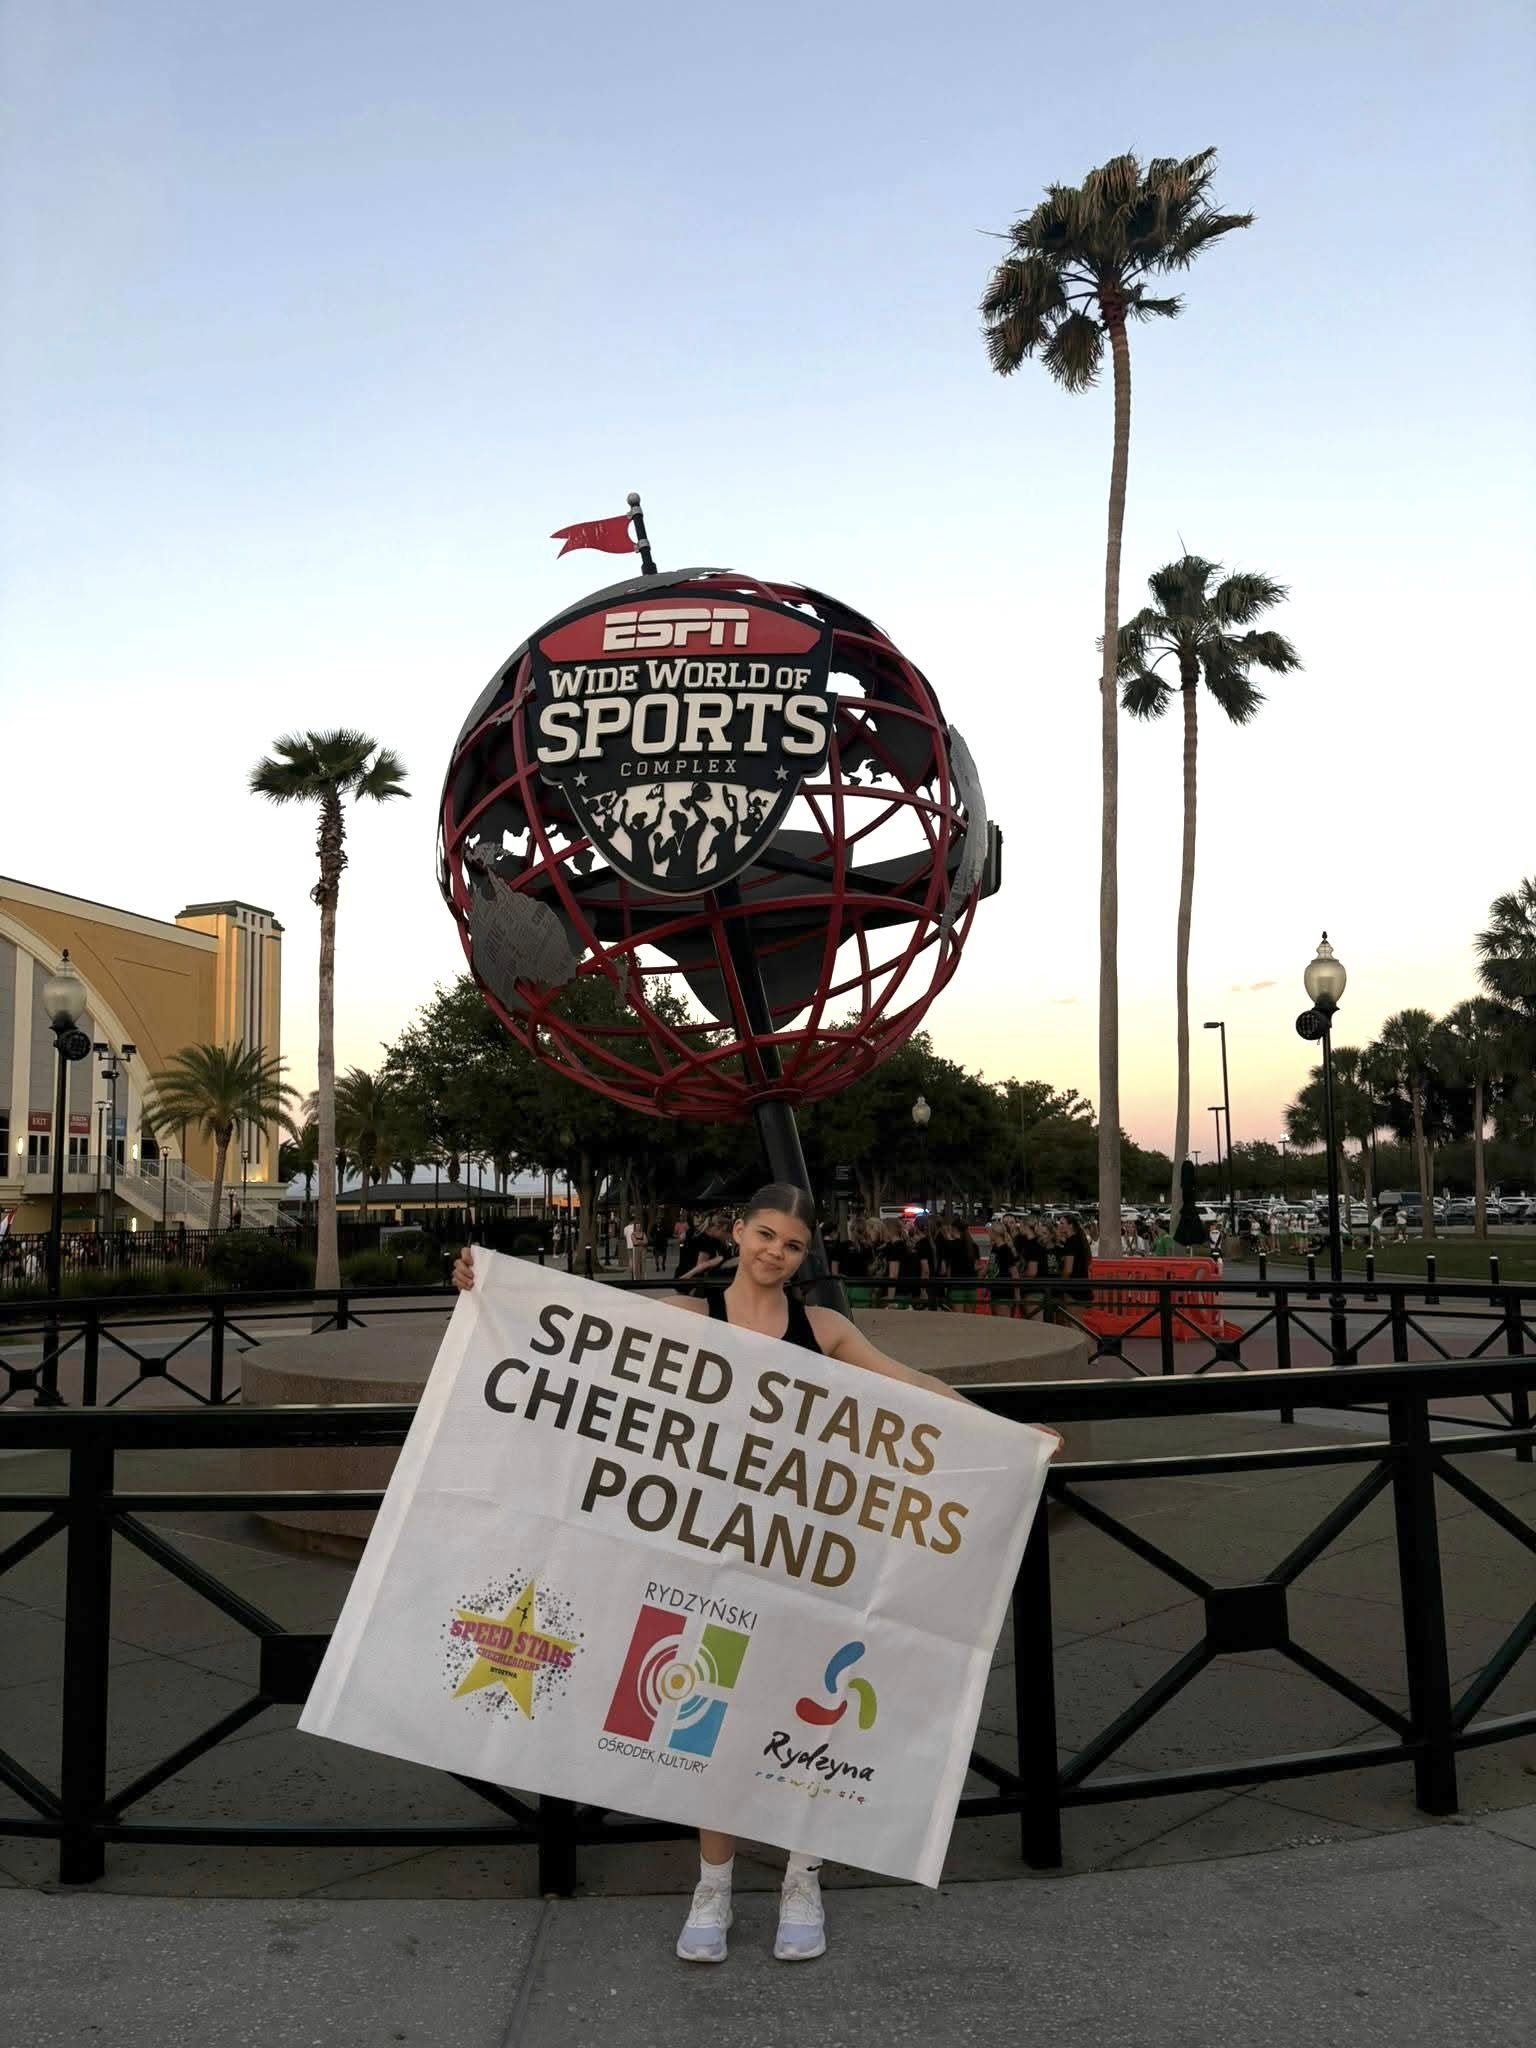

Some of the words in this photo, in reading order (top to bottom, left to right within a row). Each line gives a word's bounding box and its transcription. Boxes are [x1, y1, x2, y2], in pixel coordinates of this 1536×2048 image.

[603, 607, 750, 652] ESPN
[548, 664, 639, 699] WIDE
[645, 657, 770, 692] WORLD
[775, 666, 812, 692] OF
[536, 693, 830, 764] SPORTS
[620, 758, 738, 777] COMPLEX
[529, 1303, 734, 1405] SPEED
[748, 1370, 942, 1476] STARS
[483, 1357, 970, 1556] CHEERLEADERS
[579, 1456, 857, 1588] POLAND
[645, 1582, 758, 1630] RYDZYŃSKI
[450, 1620, 513, 1650] SPEED
[514, 1631, 574, 1669] STARS
[597, 1736, 656, 1763] OŚRODEK
[657, 1752, 709, 1774] KULTURY
[763, 1730, 875, 1781] Rydzyna
